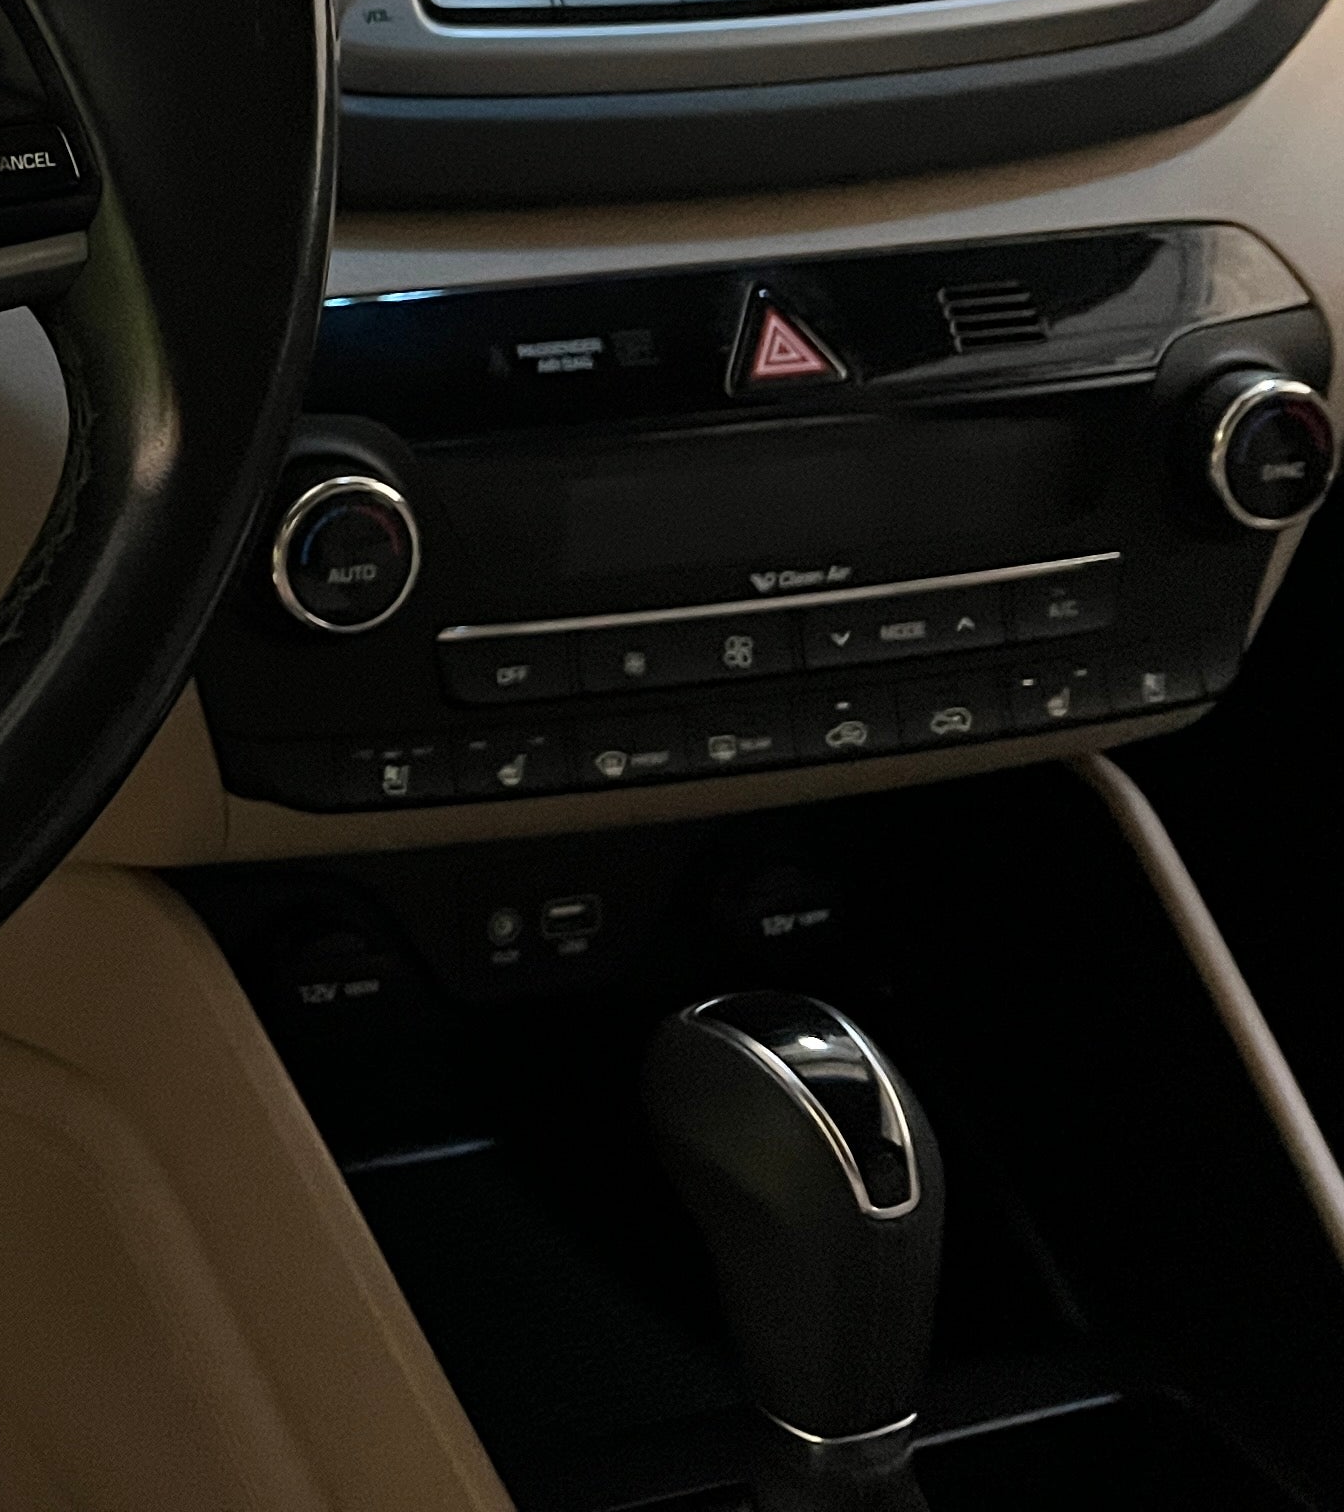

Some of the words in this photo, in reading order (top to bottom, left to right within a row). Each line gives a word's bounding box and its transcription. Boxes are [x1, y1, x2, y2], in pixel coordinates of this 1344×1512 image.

[327, 563, 378, 584] AUTO
[779, 569, 825, 589] Clean
[496, 664, 529, 686] OFF
